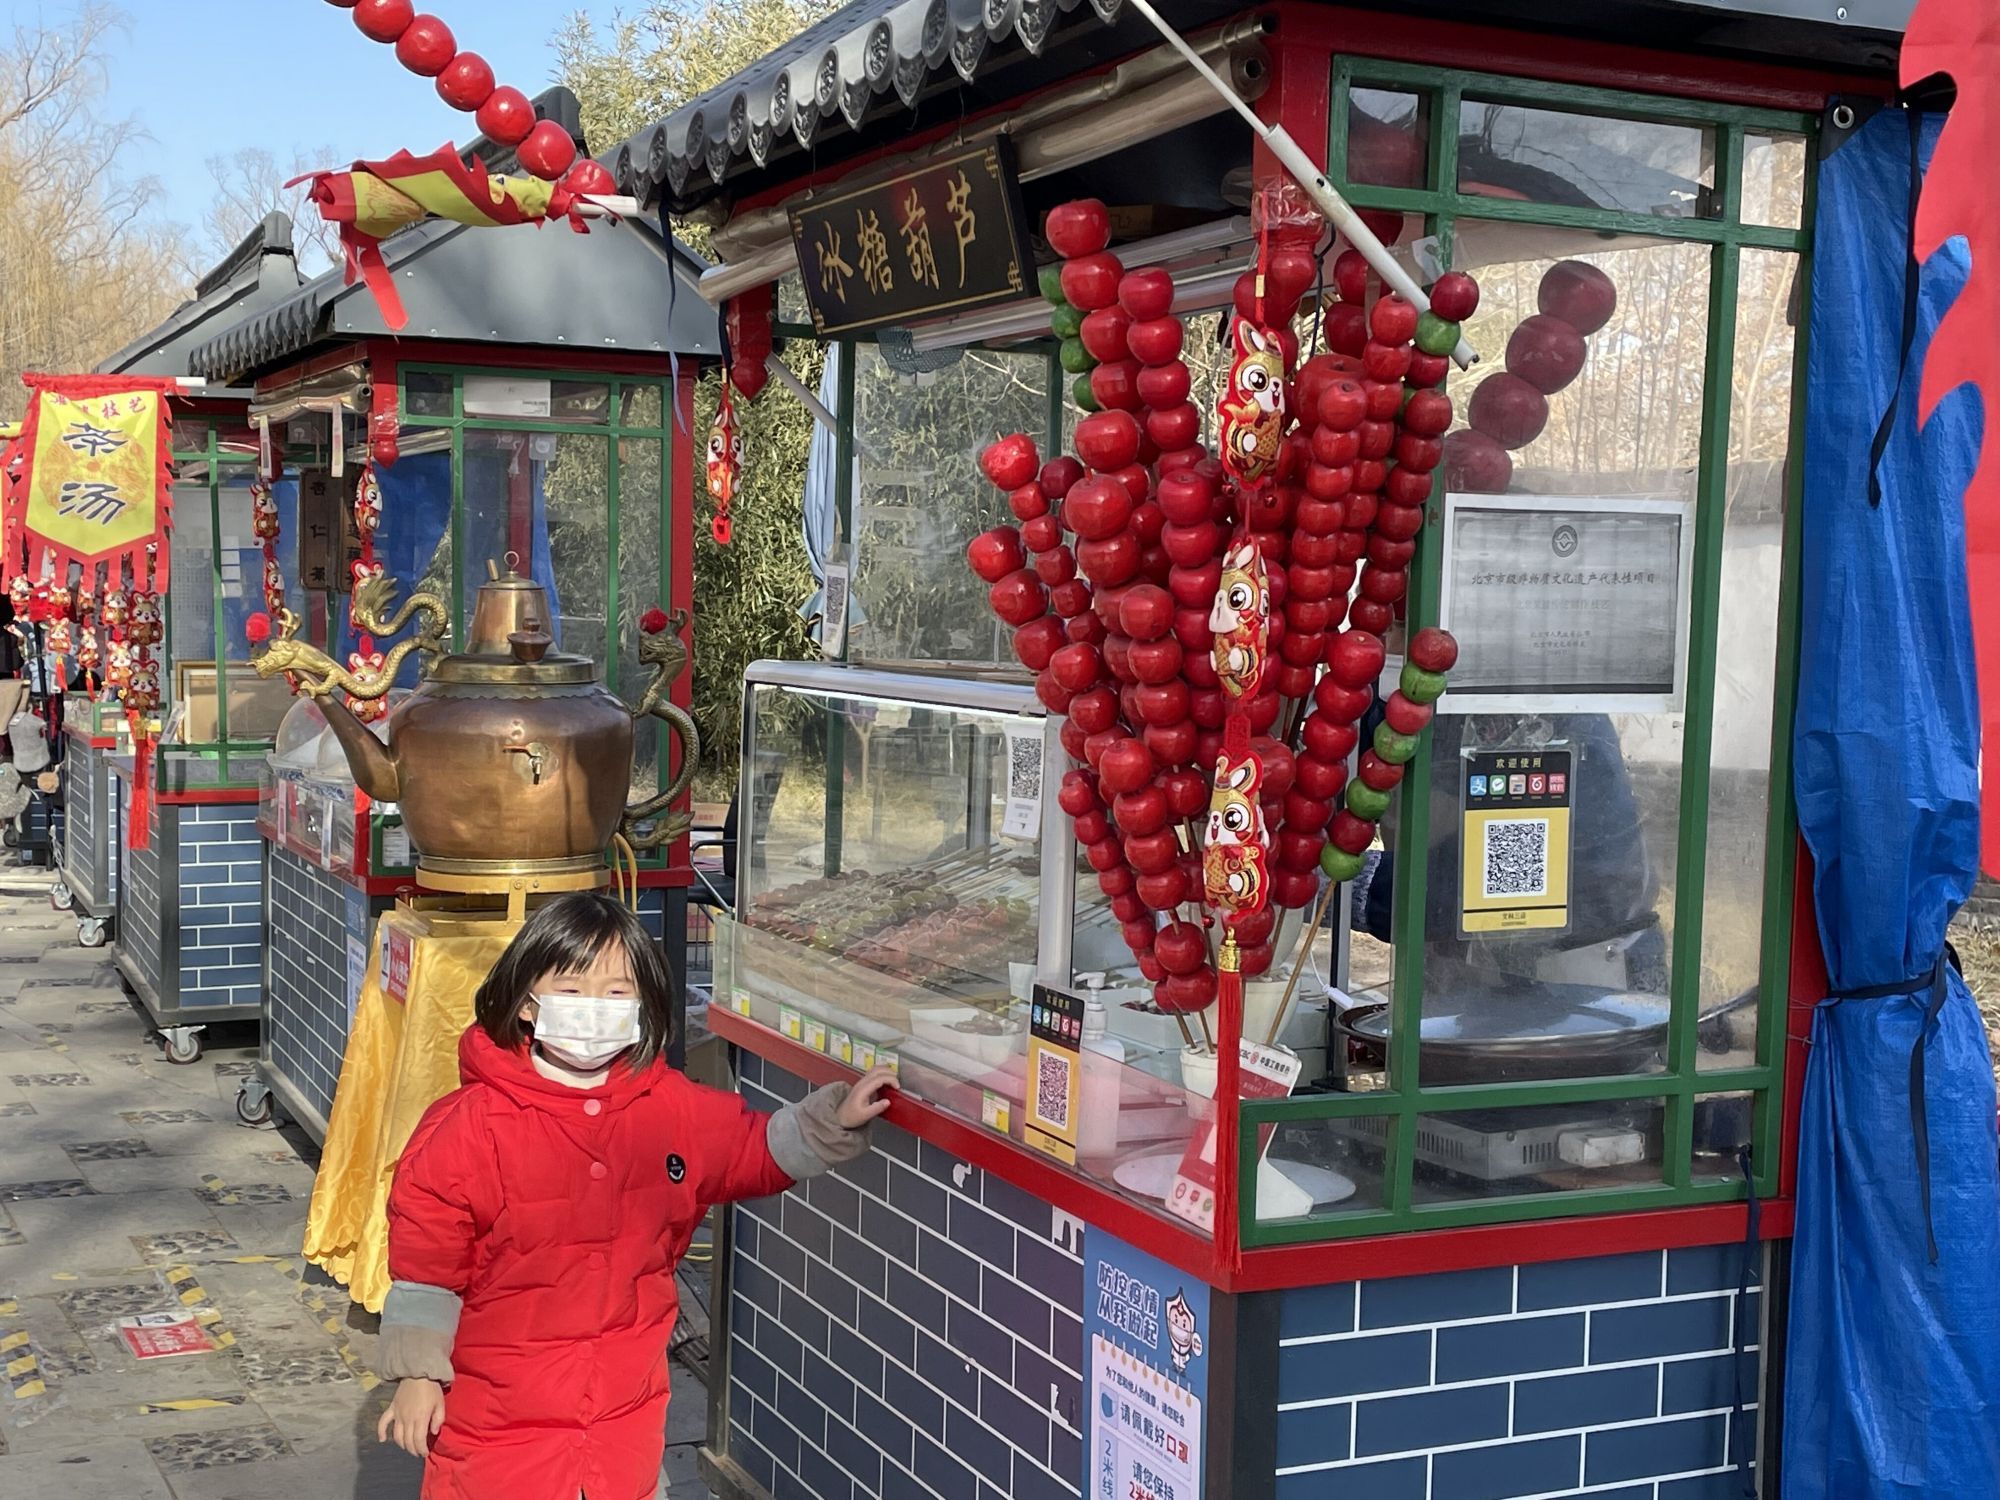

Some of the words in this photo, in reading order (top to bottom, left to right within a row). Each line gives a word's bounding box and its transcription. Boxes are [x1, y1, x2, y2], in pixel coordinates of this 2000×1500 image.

[815, 169, 976, 304] 冰糖葫芦
[59, 422, 128, 525] 茶汤
[1471, 571, 1655, 586] 北京市级非物质文化遗产代表性项目
[1495, 758, 1542, 769] 欢迎使用
[1260, 1056, 1290, 1074] 中国工商银行
[1098, 1261, 1159, 1318] 防控疫情
[1098, 1292, 1159, 1349] 从我做起
[1120, 1402, 1188, 1464] 请佩戴好口罩
